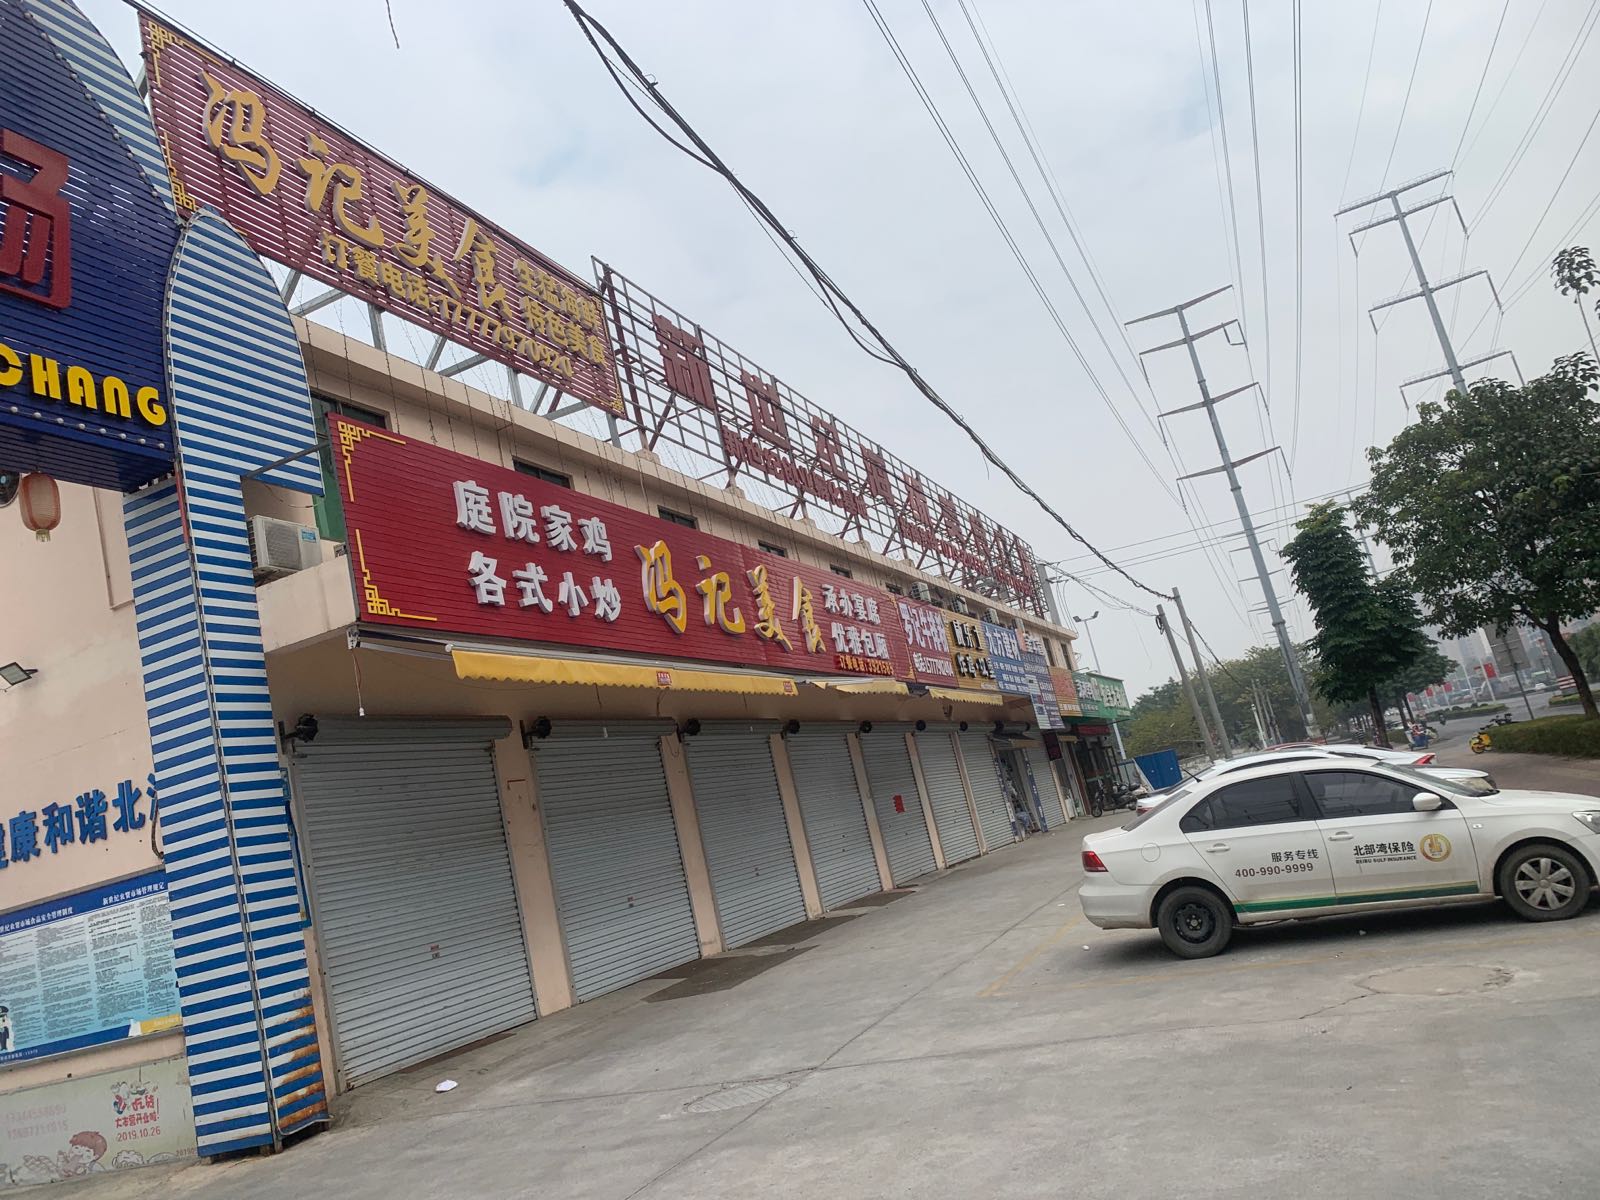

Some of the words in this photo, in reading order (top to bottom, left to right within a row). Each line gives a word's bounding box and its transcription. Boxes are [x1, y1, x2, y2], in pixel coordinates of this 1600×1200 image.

[198, 70, 509, 321] 冯记美食
[511, 259, 600, 334] 生猛海鲜
[518, 296, 607, 369] 特色美食
[453, 479, 613, 563] 庭院家鸡
[468, 550, 621, 622] 各式小炒
[633, 539, 827, 653] 冯记美食
[821, 584, 881, 625] 承办宴席
[830, 621, 890, 660] 优雅包厢
[985, 624, 1021, 661] 九方建材
[0, 773, 157, 869] 康和谐北
[1271, 848, 1319, 863] 服务专线
[1353, 841, 1415, 857] 北部湾保险
[1235, 862, 1314, 878] 400-990-9999
[102, 882, 165, 906] 新世纪农贸市场管理规定
[117, 1126, 161, 1142] 2019.10.26
